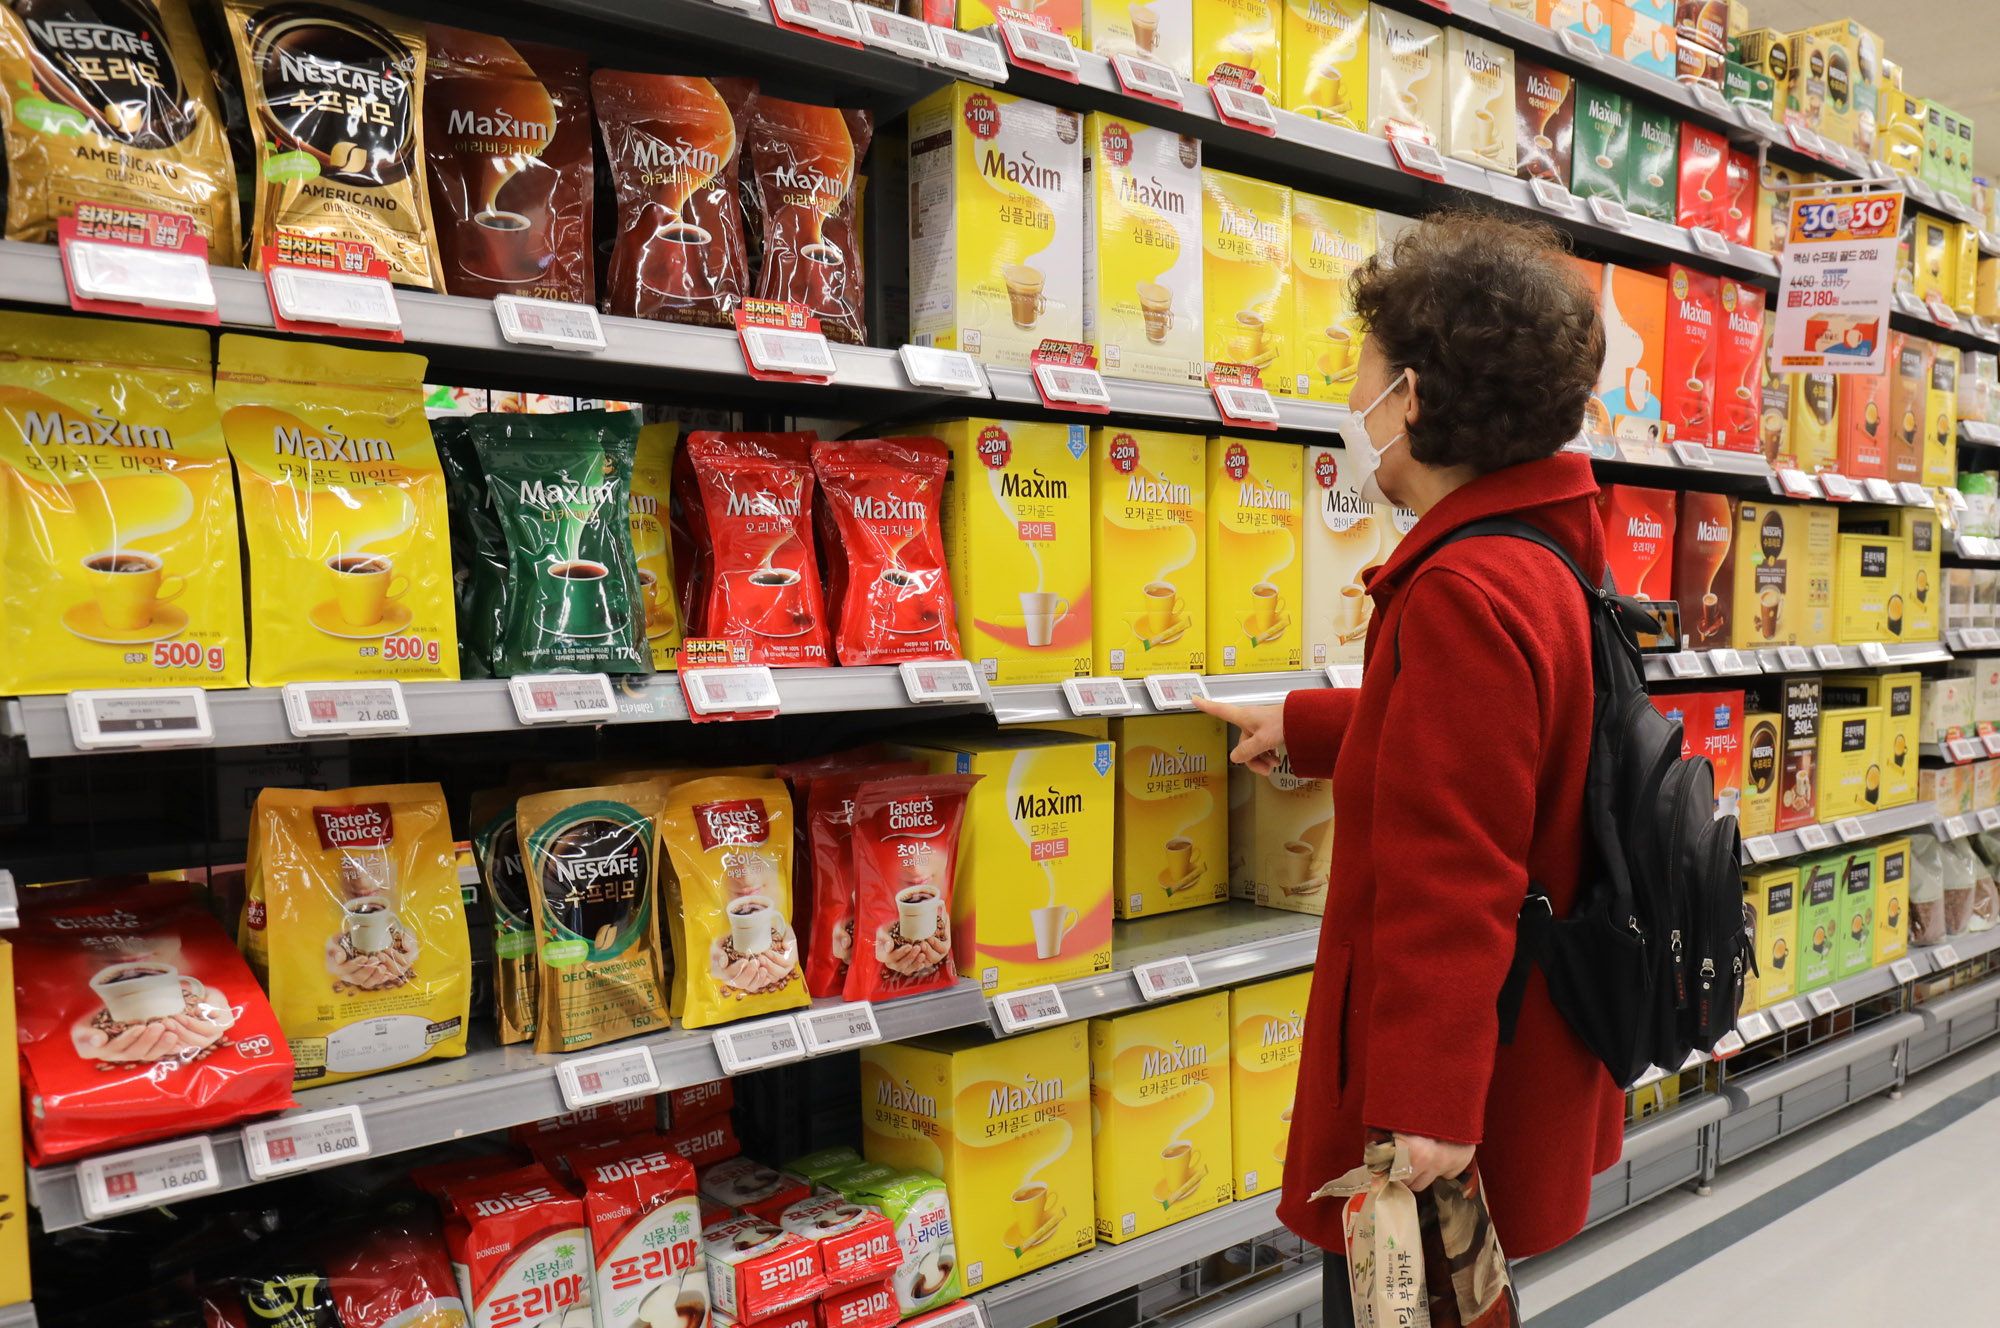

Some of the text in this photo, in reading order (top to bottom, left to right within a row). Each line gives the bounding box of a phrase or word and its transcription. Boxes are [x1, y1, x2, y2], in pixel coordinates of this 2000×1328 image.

[1464, 50, 1502, 79] Maxim
[280, 55, 396, 101] NESCAFÉ
[1727, 72, 1750, 92] Maxim
[1527, 75, 1562, 102] Maxim
[290, 89, 394, 126] 수프리모
[966, 108, 995, 122] +10개
[1588, 99, 1622, 127] Maxim
[448, 108, 549, 142] Maxim
[978, 123, 990, 136] 더!
[1641, 121, 1674, 147] Maxim
[1103, 136, 1128, 150] +10개
[77, 146, 178, 180] AMERICANO
[633, 137, 720, 175] Maxim
[1113, 151, 1124, 162] 더!
[983, 150, 1063, 192] Maxim
[776, 166, 844, 200] Maxim
[301, 184, 397, 210] AMERICANO
[1119, 176, 1185, 215] Maxim
[77, 205, 147, 229] 최저가격
[999, 204, 1049, 231] 심플라떼
[1219, 207, 1279, 244] Maxim
[156, 235, 178, 246] 보상
[157, 225, 178, 237] 차액
[278, 234, 335, 256] 최저가격
[1217, 238, 1254, 257] 모카골드
[1311, 229, 1363, 263] Maxim
[345, 253, 363, 262] 차액
[345, 260, 363, 269] 보상
[1812, 252, 1838, 263] 슈프림
[1840, 250, 1857, 262] 골드
[1859, 249, 1879, 261] 20입
[533, 286, 558, 301] 270
[745, 300, 784, 315] 최저가격
[1680, 300, 1712, 326] Maxim
[1729, 311, 1759, 336] Maxim
[21, 408, 173, 450] Maxim
[274, 424, 395, 462] Maxim
[979, 440, 1007, 453] +20개
[1111, 446, 1135, 459] +20개
[26, 453, 113, 472] 모카골드
[991, 454, 1002, 466] 더!
[1122, 461, 1131, 470] 더!
[1226, 455, 1246, 468] +20개
[1317, 464, 1334, 476] +20개
[279, 462, 404, 485] 모카골드 마일드
[1000, 468, 1067, 499] Maxim
[1234, 469, 1243, 478] 더!
[520, 469, 617, 505] Maxim
[1127, 472, 1191, 505] Maxim
[1238, 479, 1291, 510] Maxim
[726, 488, 800, 517] Maxim
[853, 492, 926, 520] Maxim
[1017, 504, 1055, 518] 모카골드
[1125, 507, 1194, 523] 모카골드 마일드
[1236, 512, 1294, 528] 모카골드 마일드
[1333, 518, 1369, 531] 화이트골드
[1022, 523, 1053, 538] 라이트
[1627, 513, 1662, 538] Maxim
[1697, 517, 1728, 542] Maxim
[153, 641, 225, 672] 500 g
[383, 637, 440, 663] 500 g
[686, 640, 726, 653] 최저가격
[733, 647, 746, 655] 차액
[1288, 648, 1301, 660] 200
[733, 654, 746, 662] 보상
[1074, 658, 1091, 671] 200
[1189, 652, 1204, 664] 200
[620, 702, 654, 713] 디카페인
[1794, 720, 1813, 735] 초이스
[1705, 735, 1738, 755] 커피믹스
[1148, 746, 1207, 778] Maxim
[1147, 775, 1209, 794] 모카골드 마일드
[888, 796, 934, 815] Taster's
[1015, 786, 1082, 820] Maxim
[321, 808, 382, 829] Taster's
[704, 803, 759, 825] Taster's
[890, 812, 933, 829] Choice
[326, 823, 382, 843] Choice
[710, 821, 760, 840] Choice
[1031, 821, 1068, 836] 모카골드
[897, 842, 931, 857] 초이스
[1034, 841, 1066, 857] 라이트
[340, 855, 380, 870] 초이스
[556, 847, 639, 882] NESCAFÉ
[727, 852, 761, 868] 초이스
[565, 880, 635, 909] 수프리모
[1213, 883, 1227, 895] 250
[1093, 952, 1110, 965] 250
[562, 958, 647, 984] DECAF AMERICANO
[566, 1006, 599, 1018] Smooth
[632, 1015, 651, 1028] 150
[849, 1022, 872, 1034] 8.900
[239, 1037, 270, 1051] 500
[771, 1038, 796, 1051] 8.900
[1141, 1039, 1207, 1081] Maxim
[1260, 1047, 1295, 1066] 모카골드
[623, 1072, 650, 1087] 9.000
[1139, 1068, 1210, 1098] 모카골드 마일드
[683, 1079, 722, 1107] 프리마
[877, 1079, 938, 1118] Maxim
[987, 1073, 1063, 1118] Maxim
[875, 1108, 940, 1137] 모카골드 마일드
[985, 1103, 1067, 1138] 모카골드 마일드
[317, 1136, 358, 1155] 18.600
[161, 1169, 207, 1190] 18.600
[1215, 1184, 1231, 1196] 250
[596, 1207, 632, 1223] DONGSUH
[920, 1207, 946, 1226] 프리마
[918, 1220, 951, 1244] 라이트
[1075, 1226, 1093, 1242] 250
[476, 1242, 511, 1259] DONGSUH
[838, 1234, 889, 1269] 프리마
[610, 1238, 698, 1291] 프리마
[760, 1257, 813, 1291] 프리마
[1397, 1250, 1414, 1301] 부침가루
[489, 1274, 583, 1328] 프리마
[840, 1290, 890, 1325] 프리마
